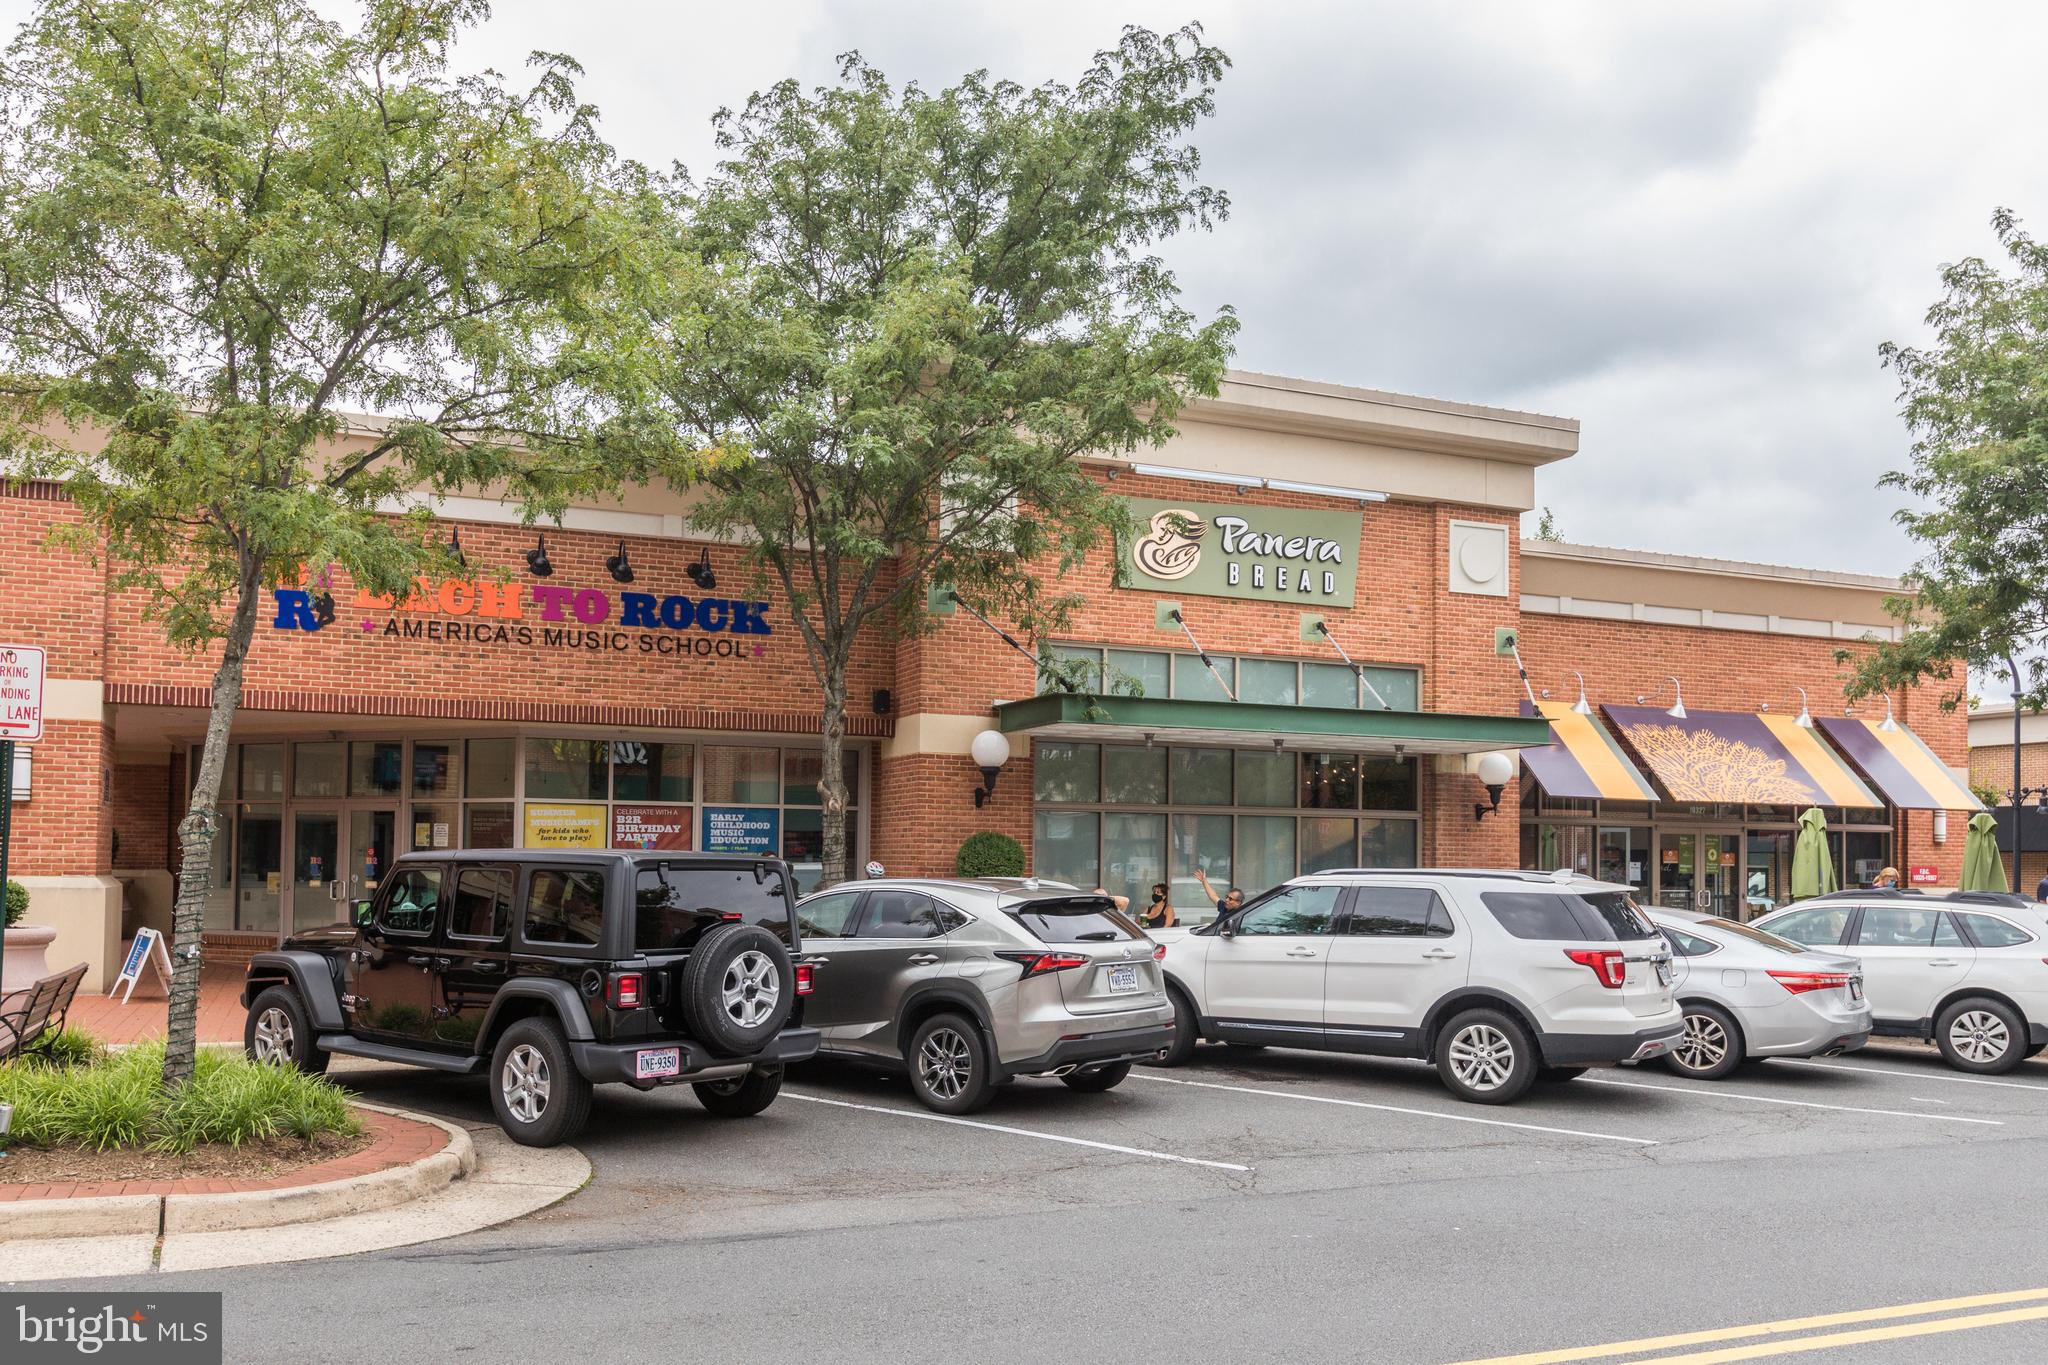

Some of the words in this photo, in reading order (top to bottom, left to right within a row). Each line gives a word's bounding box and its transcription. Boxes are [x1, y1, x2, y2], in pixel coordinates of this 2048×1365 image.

[1214, 516, 1342, 563] Panera
[1227, 561, 1336, 595] BREAD
[533, 585, 610, 625] TO
[620, 591, 772, 635] ROCK
[383, 618, 533, 646] AMERICA'S
[544, 628, 629, 651] MUSIC
[639, 634, 747, 658] SCHOOL
[0, 652, 17, 663] NO
[0, 666, 29, 679] RKING
[1, 687, 30, 700] NDING
[8, 705, 39, 721] LANE
[616, 808, 654, 816] CELEBRATE
[616, 815, 642, 824] B2R
[710, 813, 745, 821] EARLY
[616, 824, 681, 833] BIRTHDAY
[710, 821, 771, 830] CHILDHOOD
[536, 827, 552, 835] for
[710, 829, 745, 837] MUSIC
[568, 834, 592, 842] play!
[616, 833, 659, 842] PARTY
[710, 836, 770, 845] EDUCATION
[640, 1056, 677, 1071] UNE-9350
